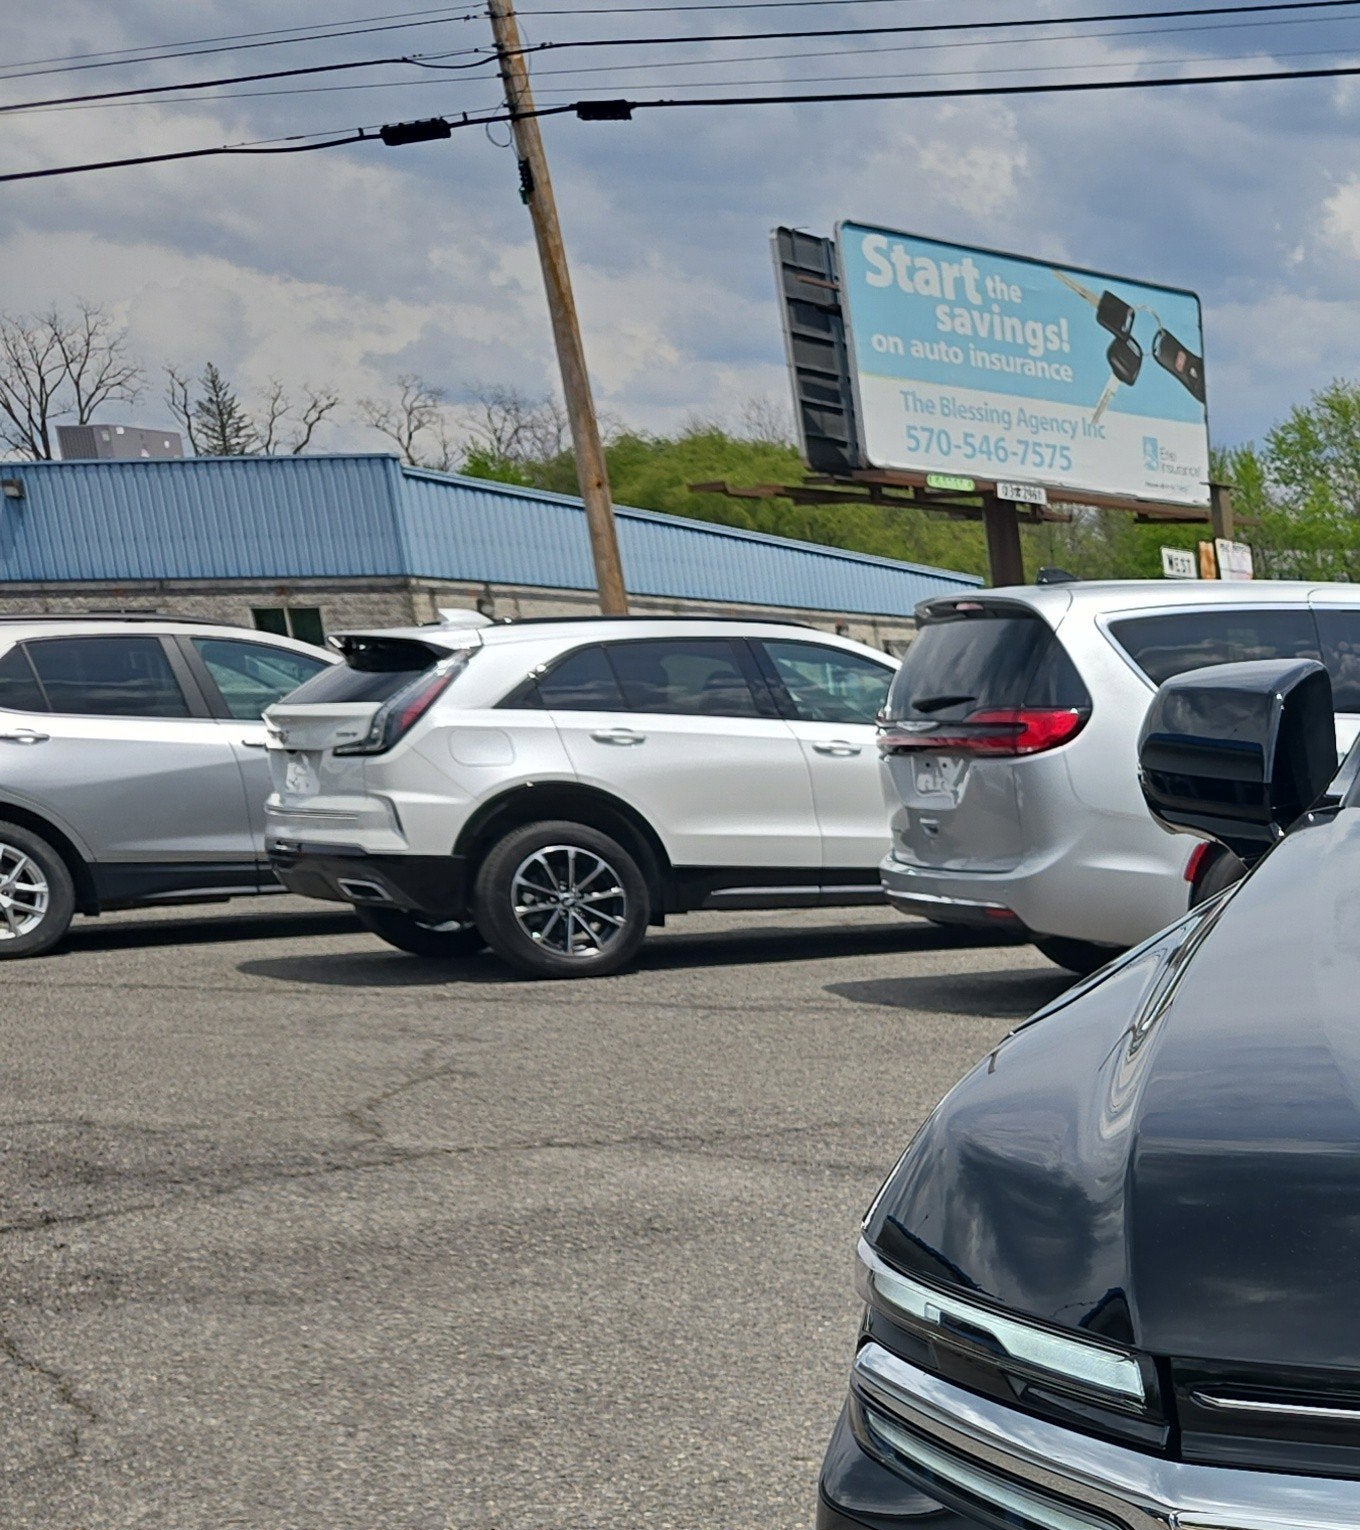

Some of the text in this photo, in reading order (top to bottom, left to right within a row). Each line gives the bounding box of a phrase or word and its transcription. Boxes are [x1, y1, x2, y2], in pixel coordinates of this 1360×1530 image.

[862, 233, 1022, 306] Start the
[935, 304, 1071, 357] savings!
[871, 333, 1073, 383] on auto insurance
[900, 390, 1106, 440] The Blessing Agency Inc
[905, 425, 1073, 472] 570-546-7575
